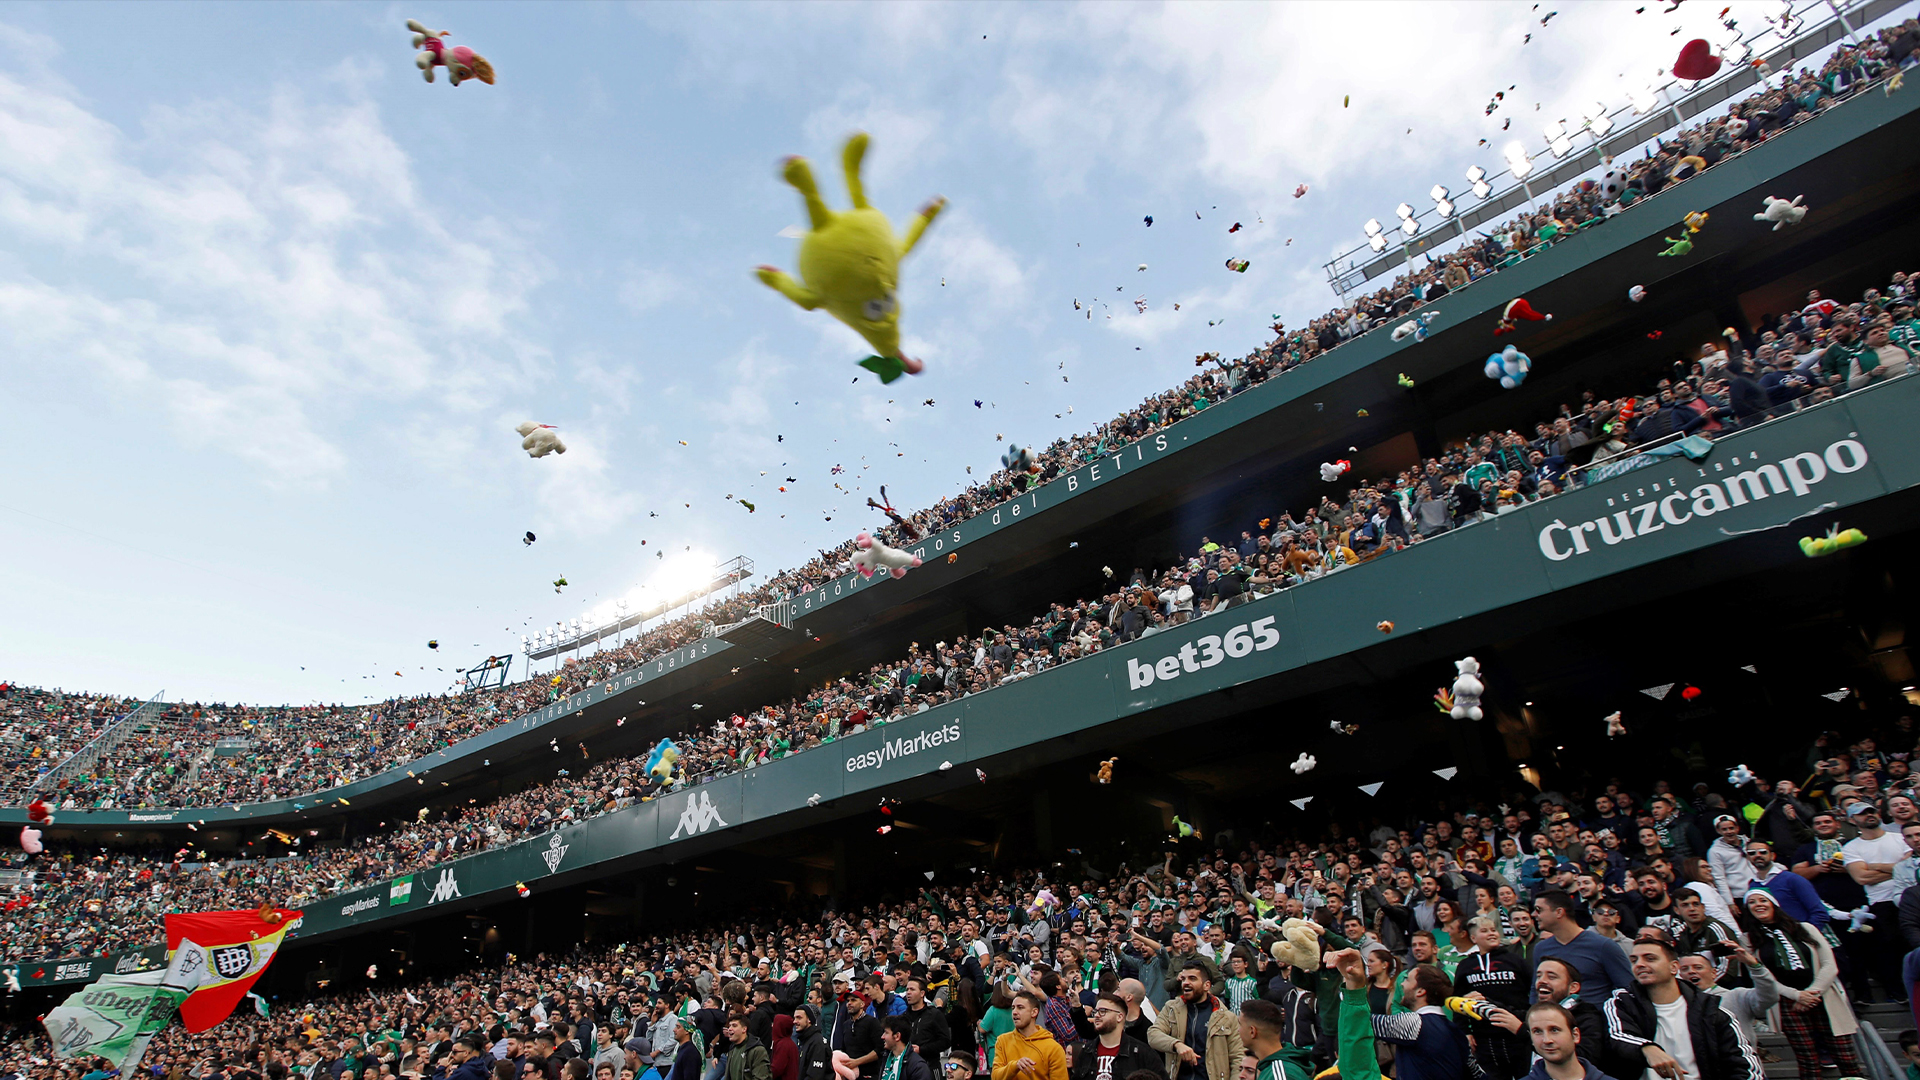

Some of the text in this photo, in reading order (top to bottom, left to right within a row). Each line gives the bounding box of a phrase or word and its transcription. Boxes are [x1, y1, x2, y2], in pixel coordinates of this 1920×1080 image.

[1538, 439, 1869, 561] Cruzcampo
[1606, 477, 1677, 507] DESDE
[1697, 451, 1759, 478] 1904
[879, 531, 961, 576] smos
[992, 493, 1037, 526] del
[1127, 615, 1281, 691] bet365
[522, 693, 591, 729] Apiñados
[658, 643, 708, 673] balas
[846, 723, 961, 773] easyMarkets
[341, 897, 380, 916] easyMarkets
[67, 962, 93, 972] REALE
[1466, 971, 1516, 983] HOLLISTER
